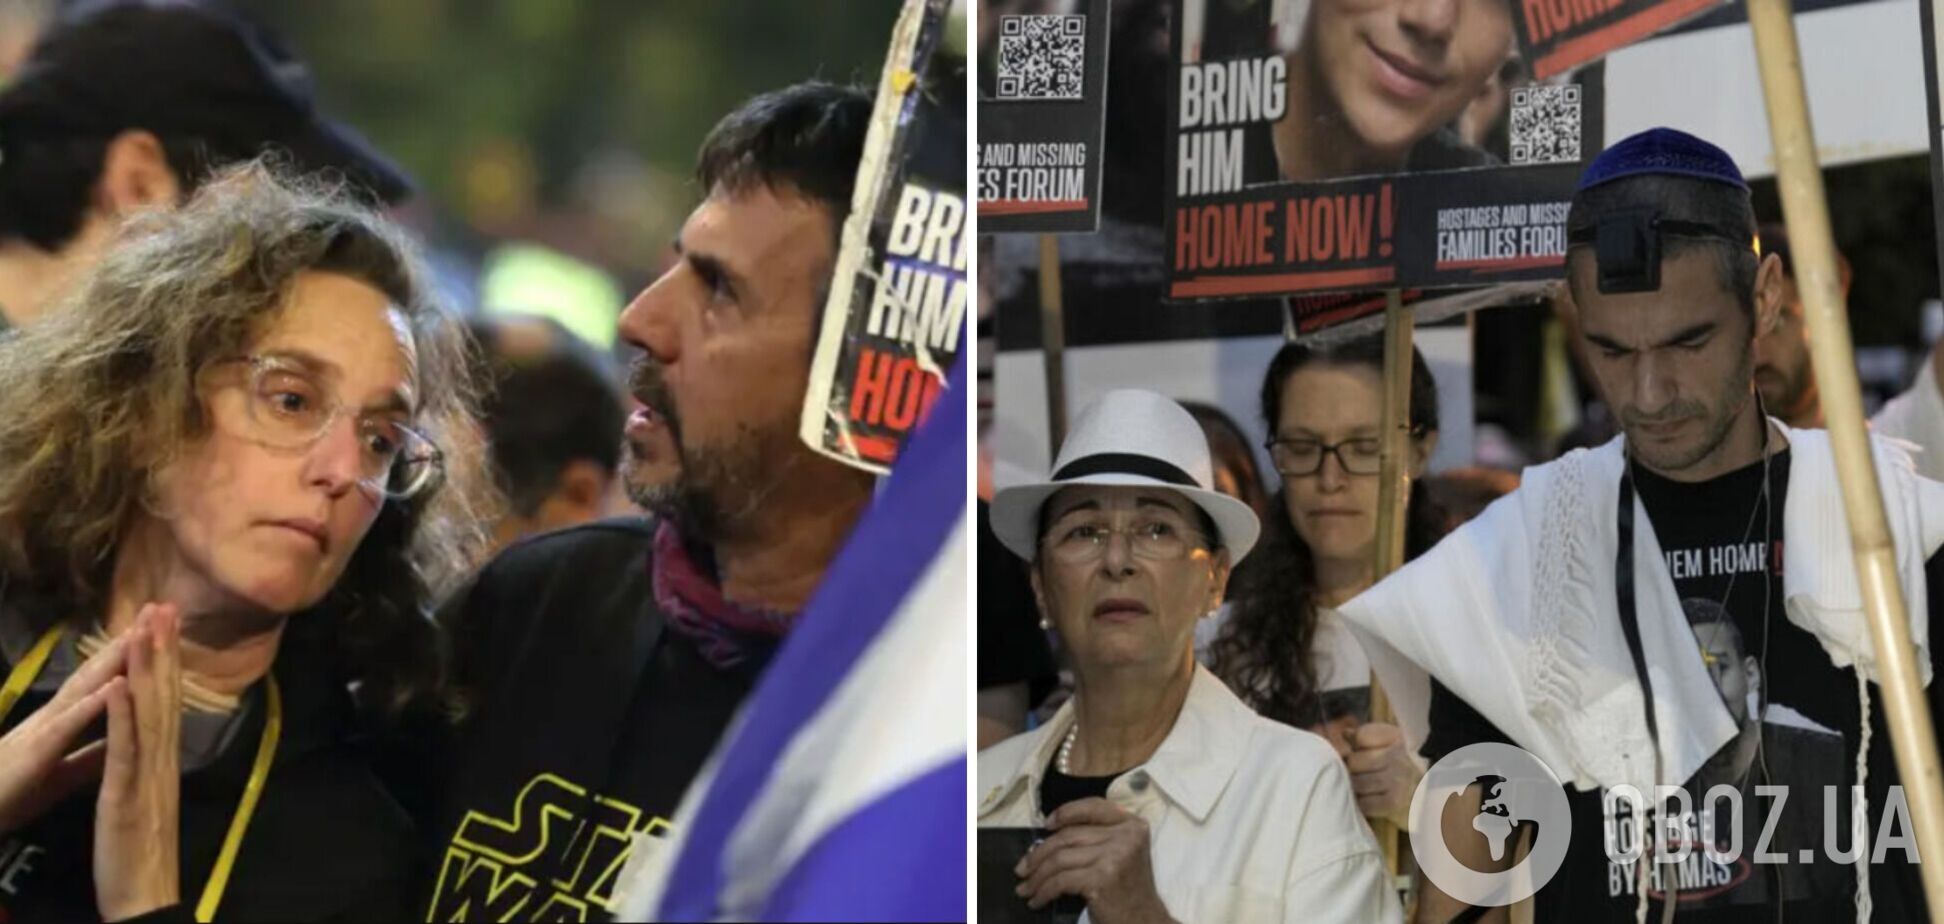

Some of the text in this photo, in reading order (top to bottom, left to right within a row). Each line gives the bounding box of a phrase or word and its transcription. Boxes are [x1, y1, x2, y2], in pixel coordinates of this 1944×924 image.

[1180, 55, 1286, 128] BRING
[983, 144, 1014, 166] AND
[1017, 143, 1086, 166] MISSING
[1177, 129, 1244, 196] HIM
[1006, 168, 1084, 202] FORUM
[1438, 206, 1500, 230] HOSTAGES
[1502, 204, 1527, 226] AND
[1176, 203, 1275, 271] HOME
[1437, 228, 1517, 261] FAMILIES
[867, 260, 967, 352] HIM
[1608, 859, 1637, 897] BY
